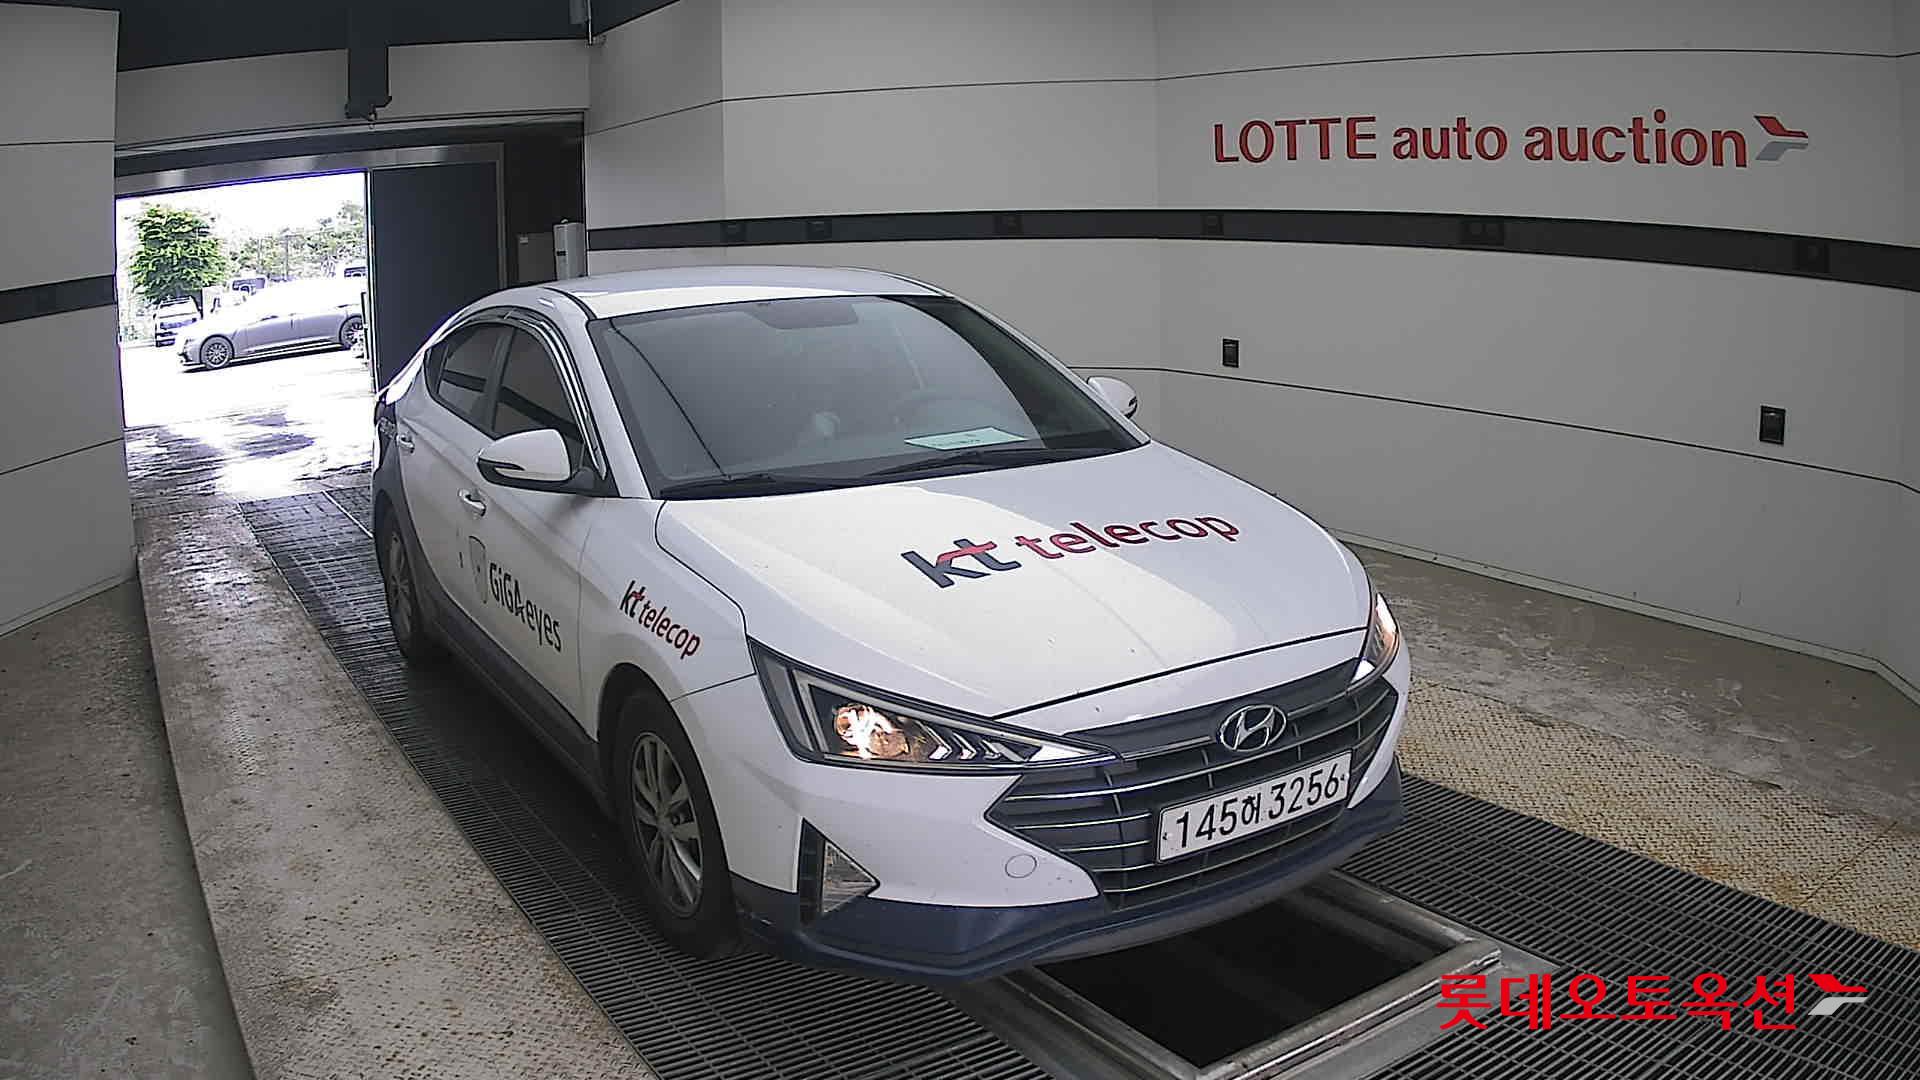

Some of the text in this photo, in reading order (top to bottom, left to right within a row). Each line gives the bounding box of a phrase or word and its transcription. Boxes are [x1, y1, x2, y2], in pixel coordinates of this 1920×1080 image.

[1213, 108, 1748, 169] LOTTE auto auction
[900, 515, 1240, 588] kt telecop
[619, 579, 701, 660] kt telecop
[1267, 762, 1339, 820] 3256
